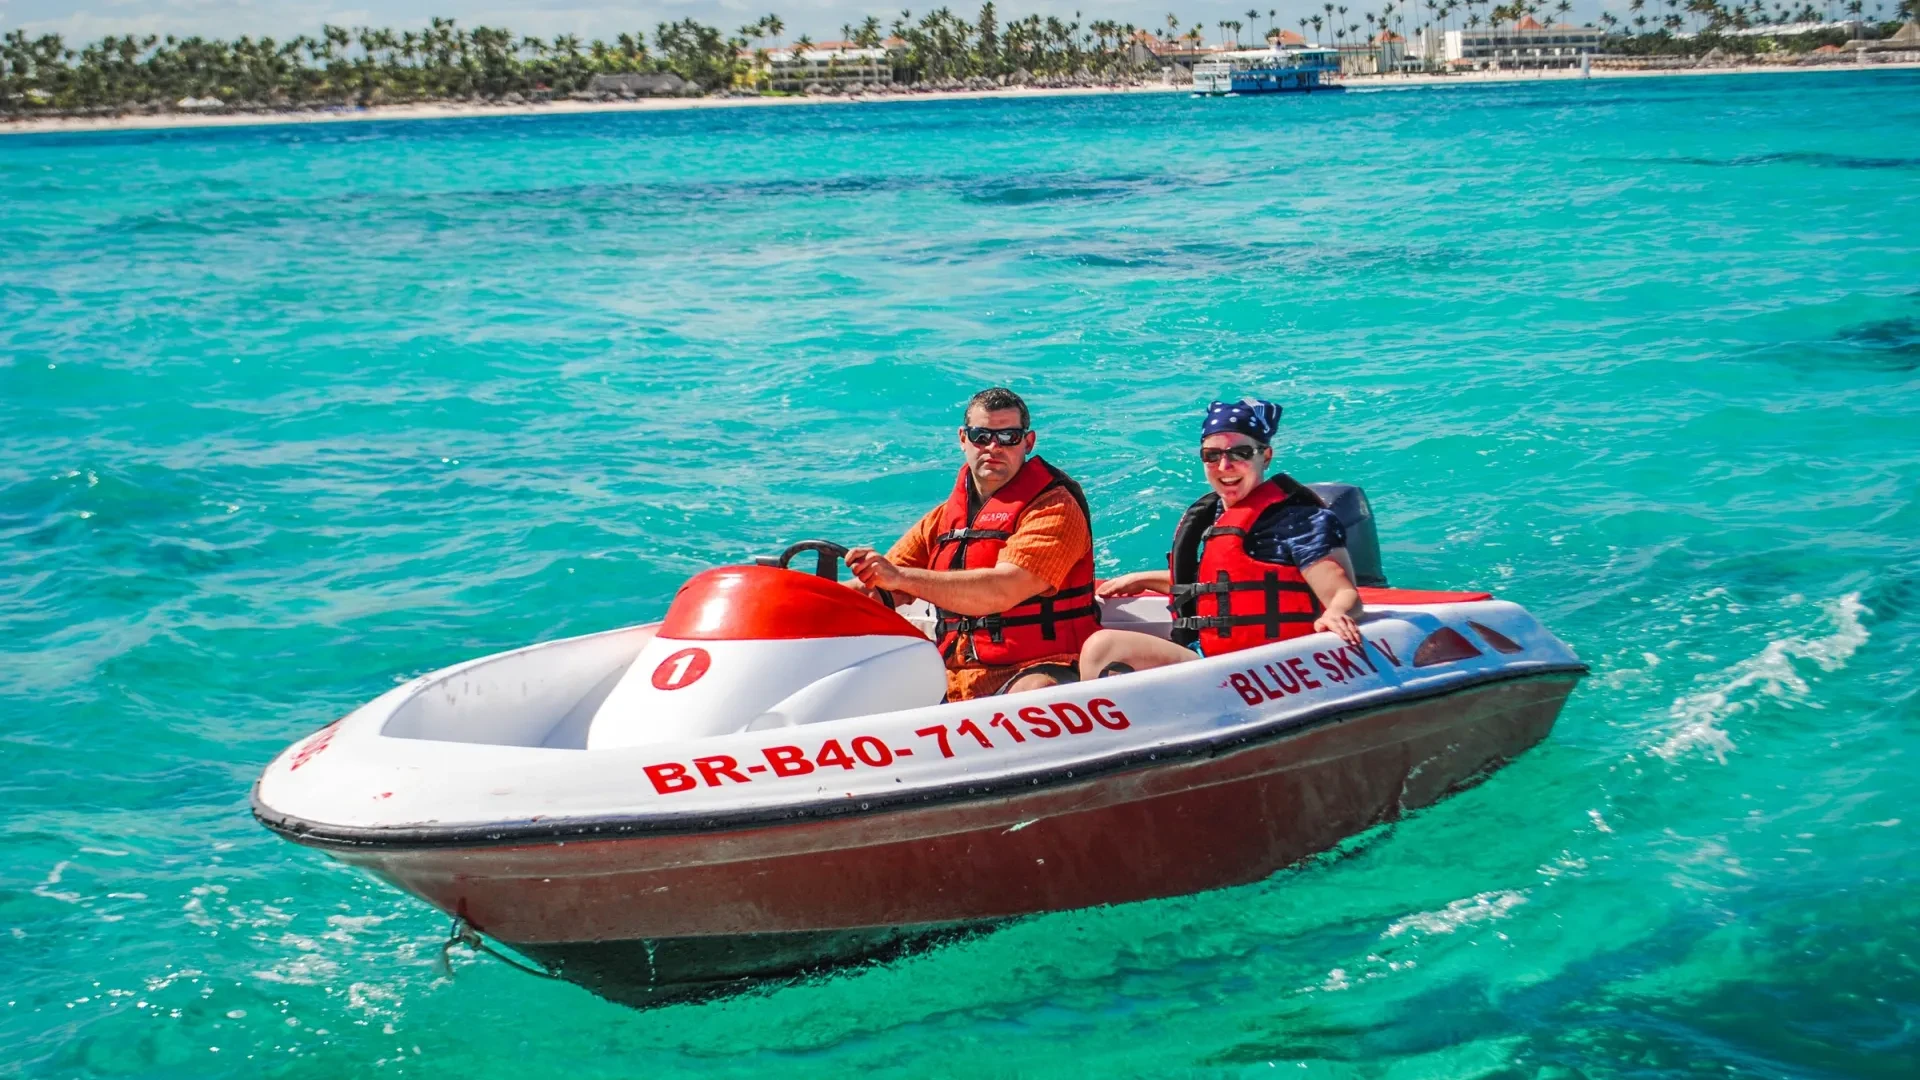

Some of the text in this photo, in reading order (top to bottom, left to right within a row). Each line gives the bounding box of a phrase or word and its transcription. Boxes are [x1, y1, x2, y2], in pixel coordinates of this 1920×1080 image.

[667, 653, 696, 685] 1
[1229, 638, 1402, 706] BLUE SKY V
